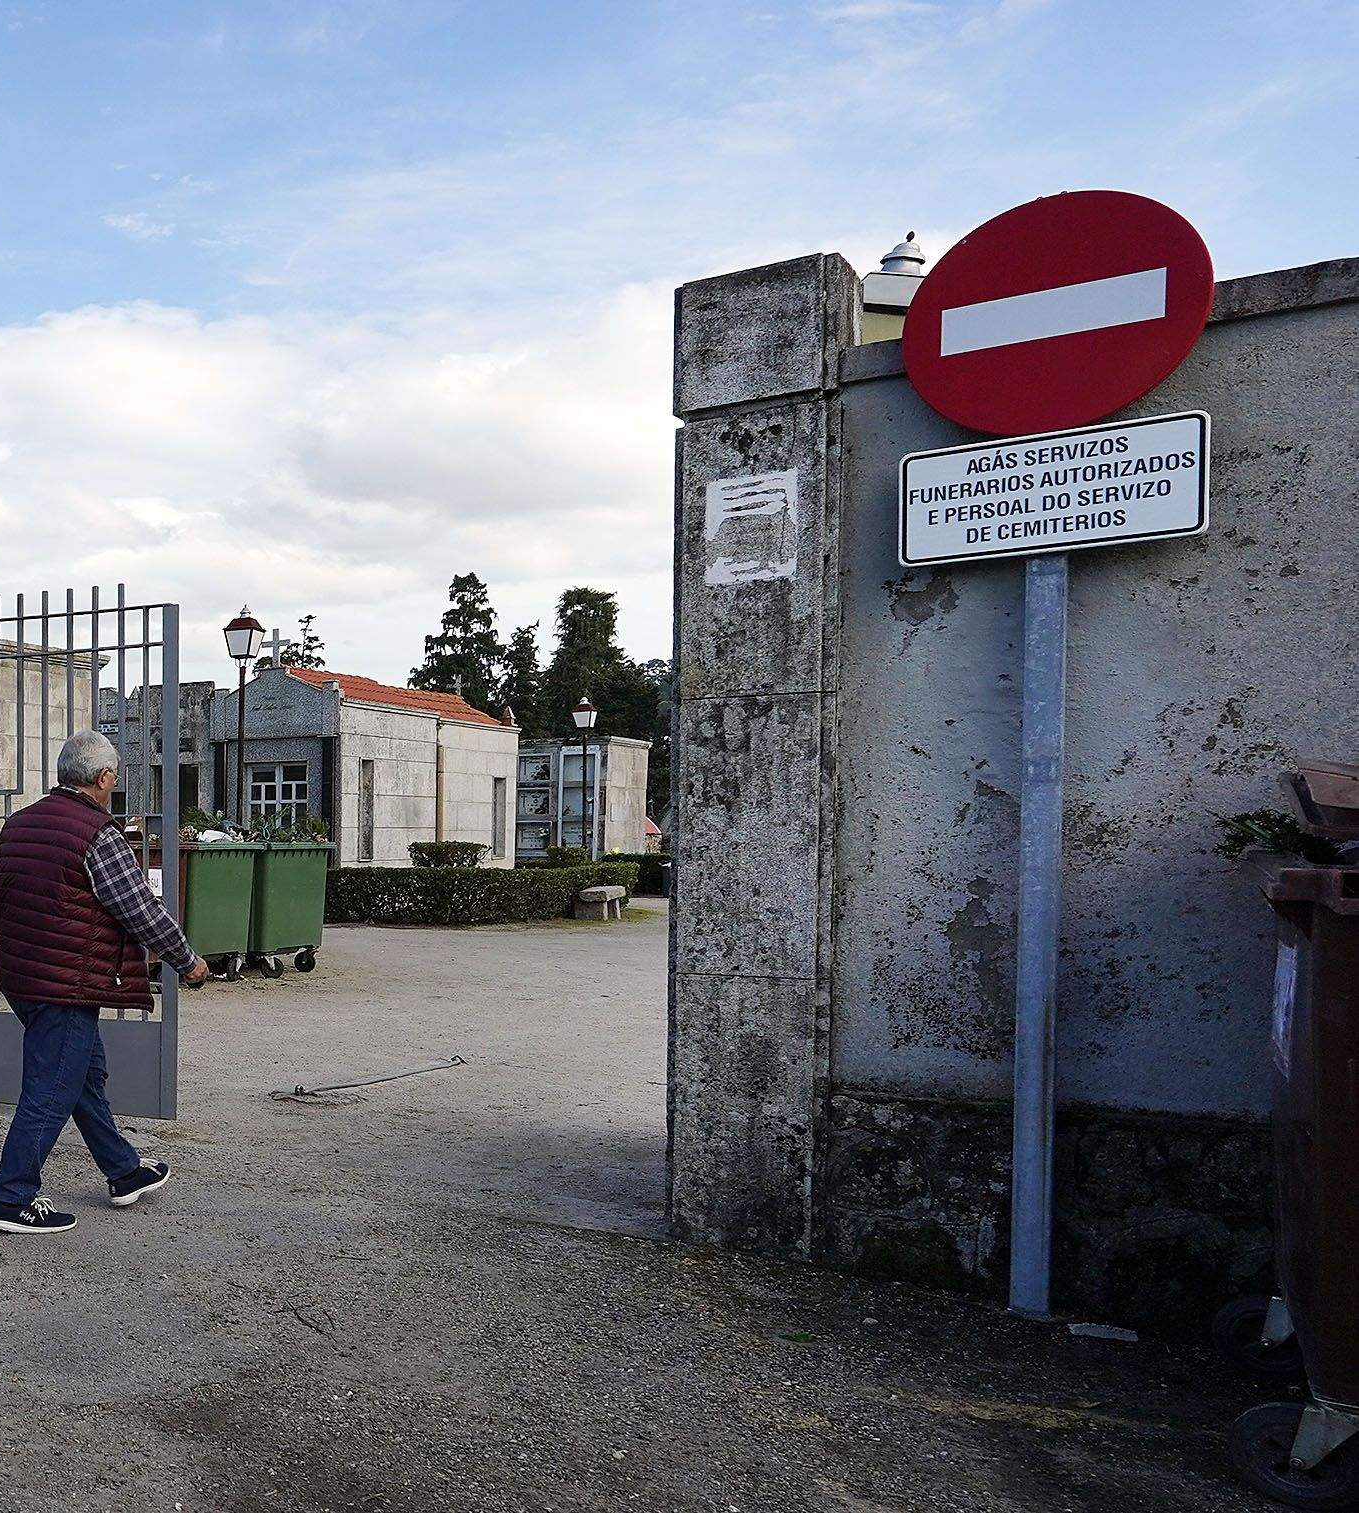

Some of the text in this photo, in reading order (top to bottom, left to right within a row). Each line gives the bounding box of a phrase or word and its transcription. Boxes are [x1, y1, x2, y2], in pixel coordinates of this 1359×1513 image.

[966, 436, 1129, 476] AGÁS SERVIZOS
[909, 451, 1196, 505] FUNERARIOS AUTORIZADOS
[928, 479, 1172, 526] E PERSOAL DO SERVIZO
[966, 509, 1127, 544] DE CEMITERIOS
